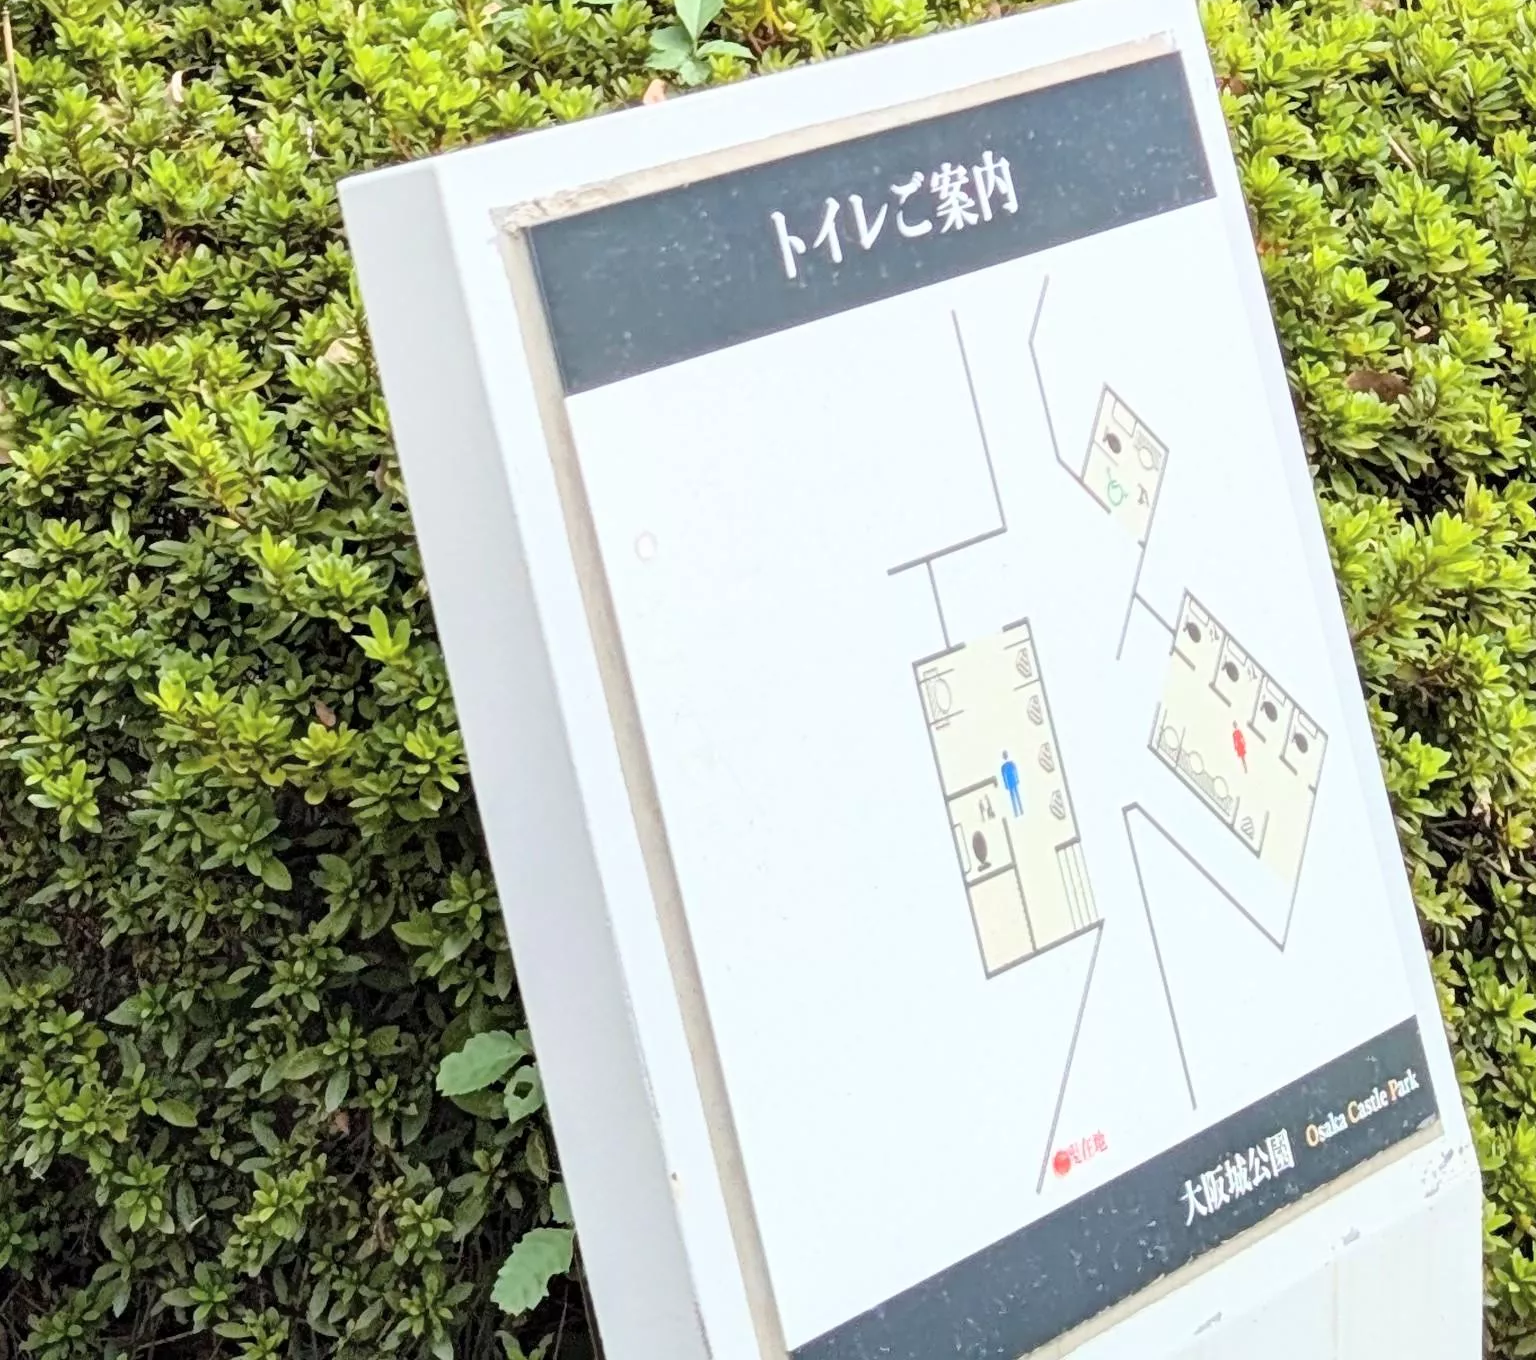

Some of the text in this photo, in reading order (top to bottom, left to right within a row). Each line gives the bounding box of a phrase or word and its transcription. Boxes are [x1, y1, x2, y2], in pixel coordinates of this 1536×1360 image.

[770, 150, 1019, 279] トイレご案内
[1305, 1068, 1420, 1148] Osaka Castle Park
[1179, 1127, 1295, 1227] 大阪城公園
